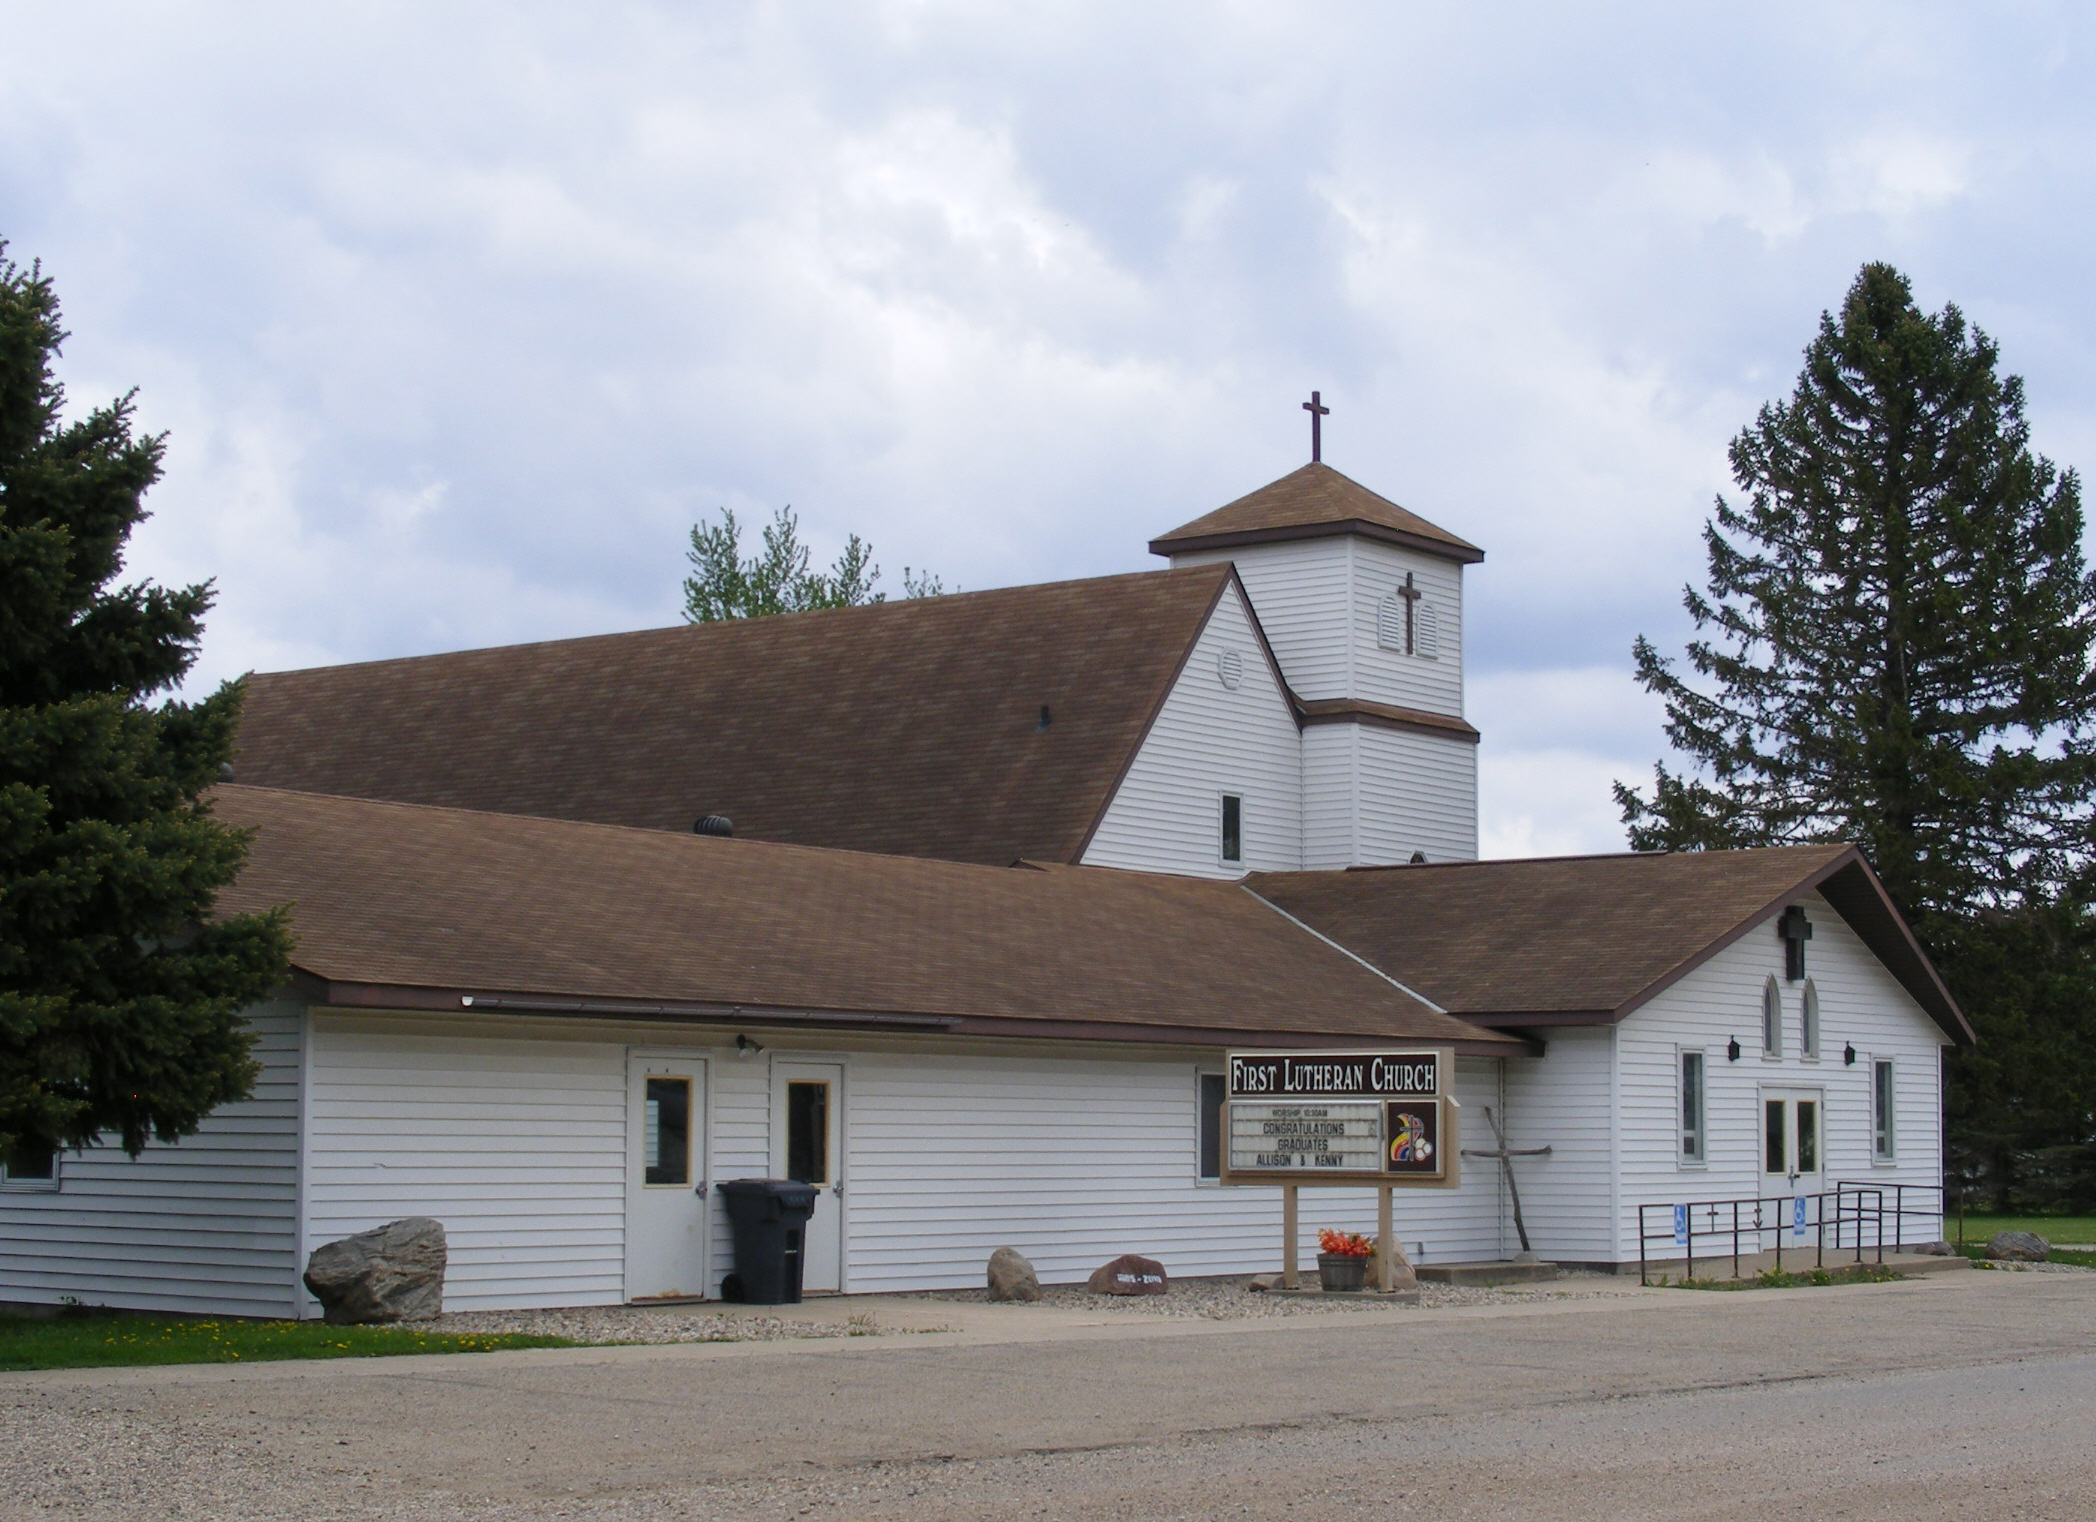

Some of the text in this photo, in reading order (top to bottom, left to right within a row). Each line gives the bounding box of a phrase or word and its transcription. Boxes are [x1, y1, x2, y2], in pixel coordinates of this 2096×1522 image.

[1232, 1058, 1435, 1091] FIRST LUTHERAN CHURCH
[1263, 1122, 1344, 1135] CONGRATULATIONS
[1277, 1138, 1328, 1151] GRADUATES
[1256, 1154, 1291, 1166] ALLISON
[1315, 1154, 1343, 1166] KENNY
